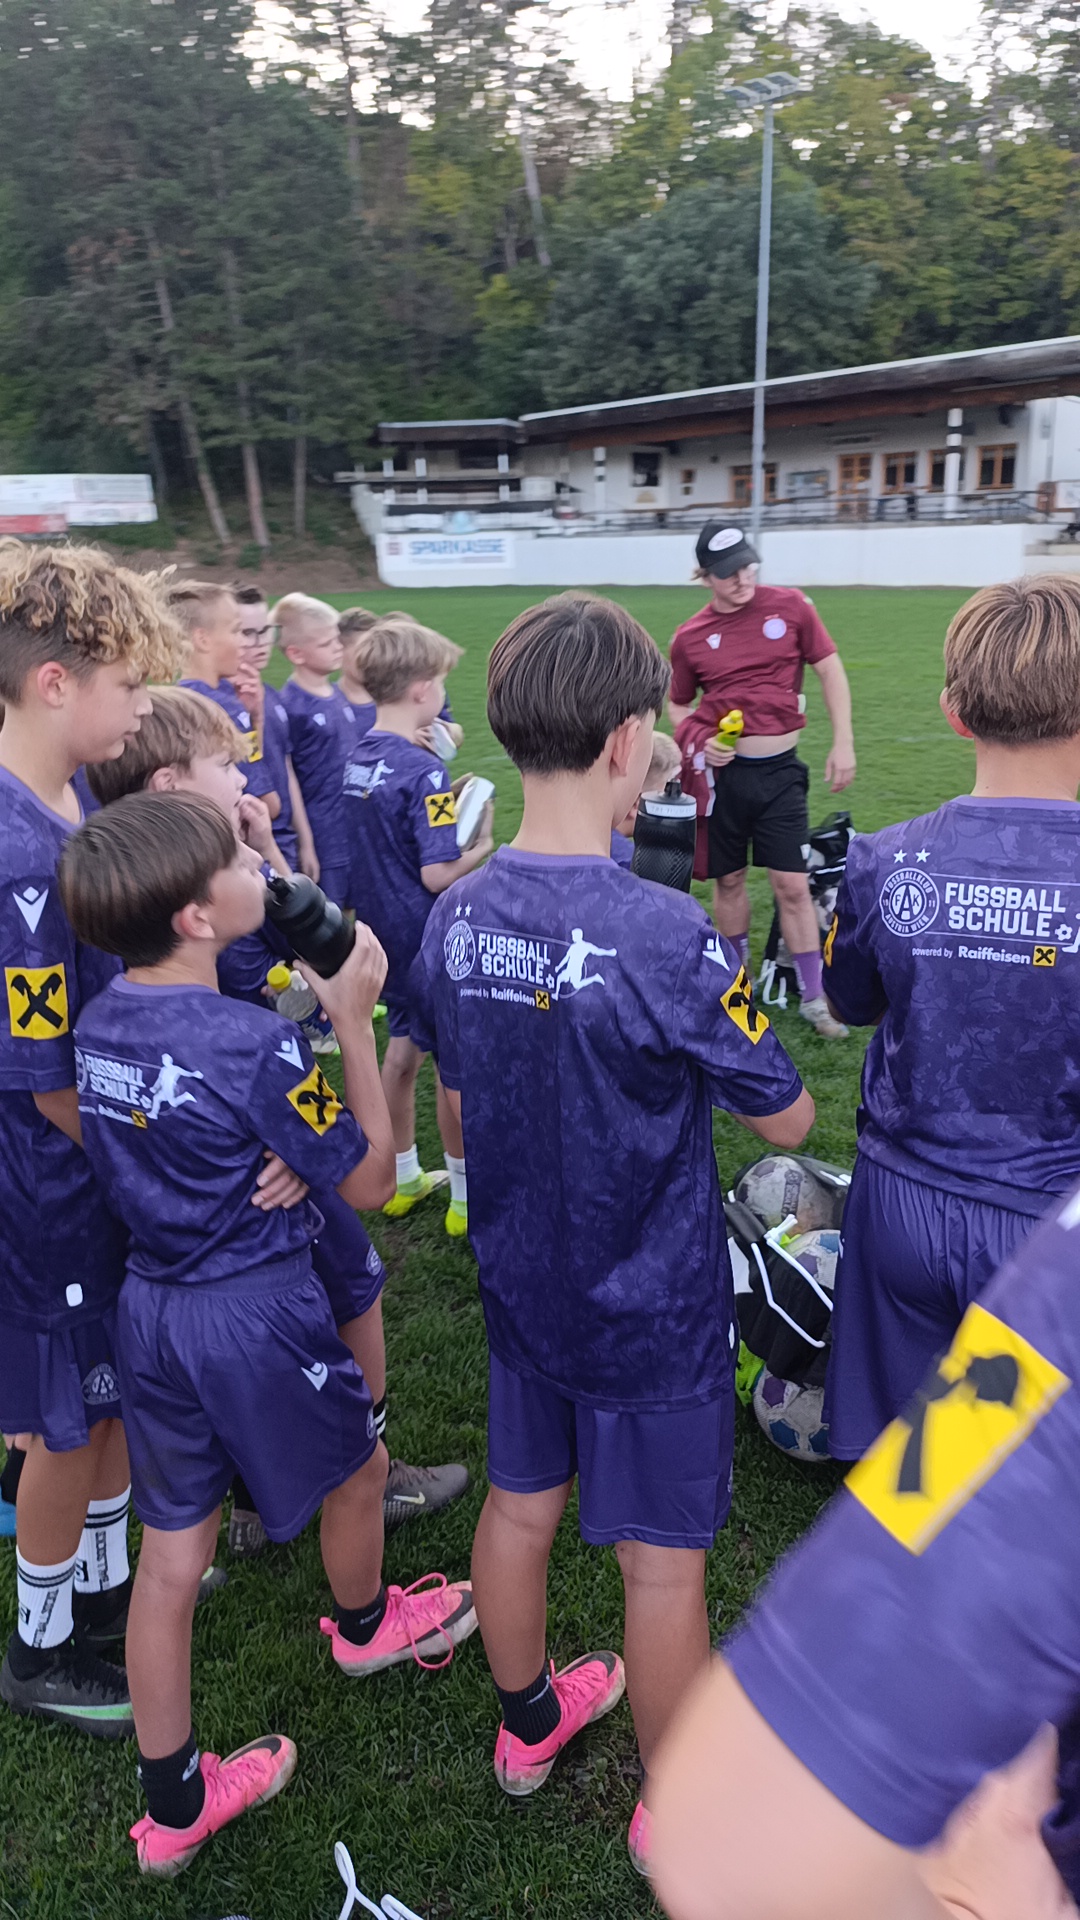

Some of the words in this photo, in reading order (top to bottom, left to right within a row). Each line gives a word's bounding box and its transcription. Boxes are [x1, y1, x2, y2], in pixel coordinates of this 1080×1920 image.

[945, 882, 1066, 913] FUSSBALL
[948, 905, 1053, 937] SCHULE
[478, 932, 551, 966] FUSSBALL
[912, 948, 942, 957] powered
[943, 948, 953, 958] by
[958, 945, 1031, 964] Raiffeisen
[481, 953, 544, 985] SCHULE
[491, 987, 535, 1007] Raiffeisen
